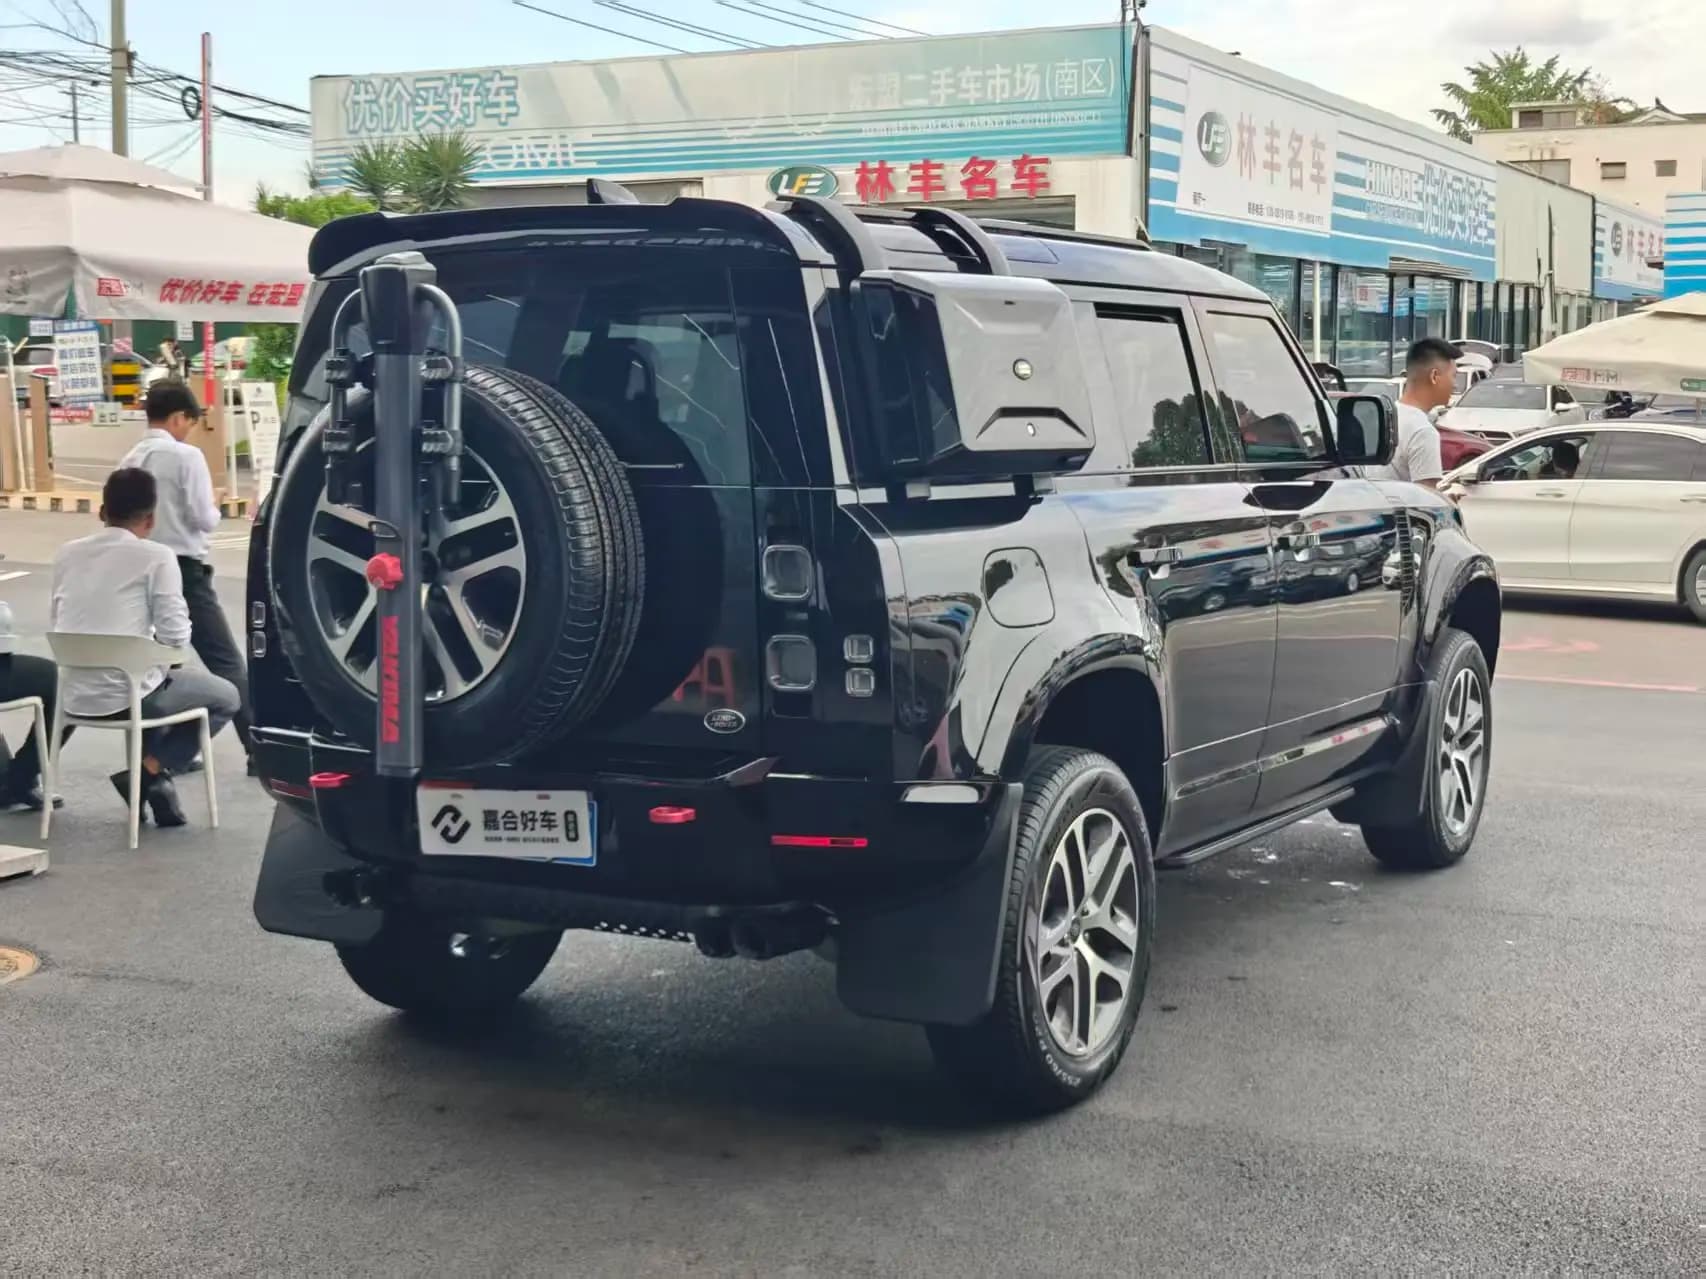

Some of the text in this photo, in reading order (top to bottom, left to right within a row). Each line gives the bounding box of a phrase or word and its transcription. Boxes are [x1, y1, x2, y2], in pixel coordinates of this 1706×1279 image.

[344, 70, 519, 134] 优价买好车
[855, 153, 1051, 204] 林丰名车
[1236, 111, 1328, 195] 林丰名车
[483, 810, 559, 832] 嘉合好车
